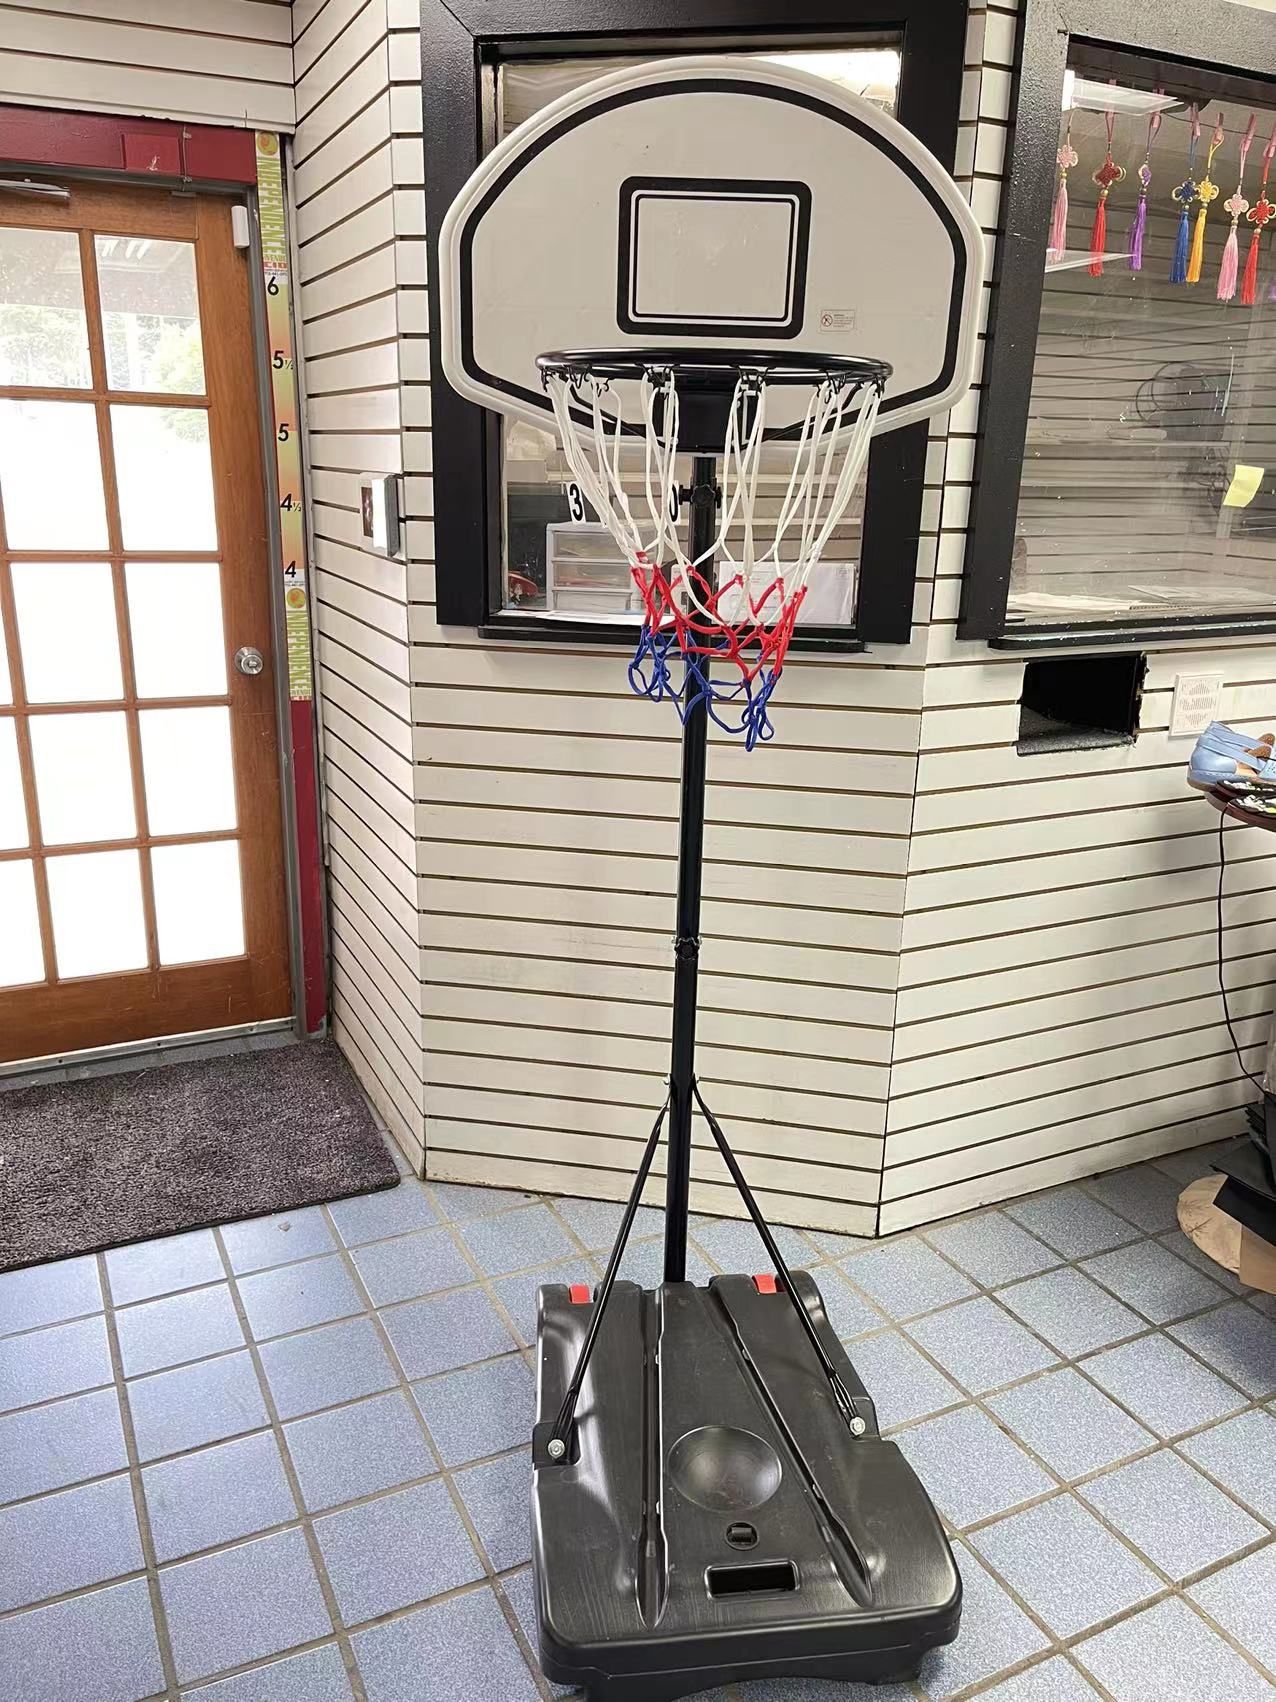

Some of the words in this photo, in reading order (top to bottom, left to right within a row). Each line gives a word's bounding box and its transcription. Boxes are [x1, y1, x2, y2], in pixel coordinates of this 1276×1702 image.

[257, 157, 284, 255] INDEPENDENCE
[268, 276, 279, 296] 6
[278, 424, 289, 442] 5
[570, 483, 583, 521] 3
[285, 560, 296, 578] 4
[287, 610, 311, 690] INDEPENDENCE
